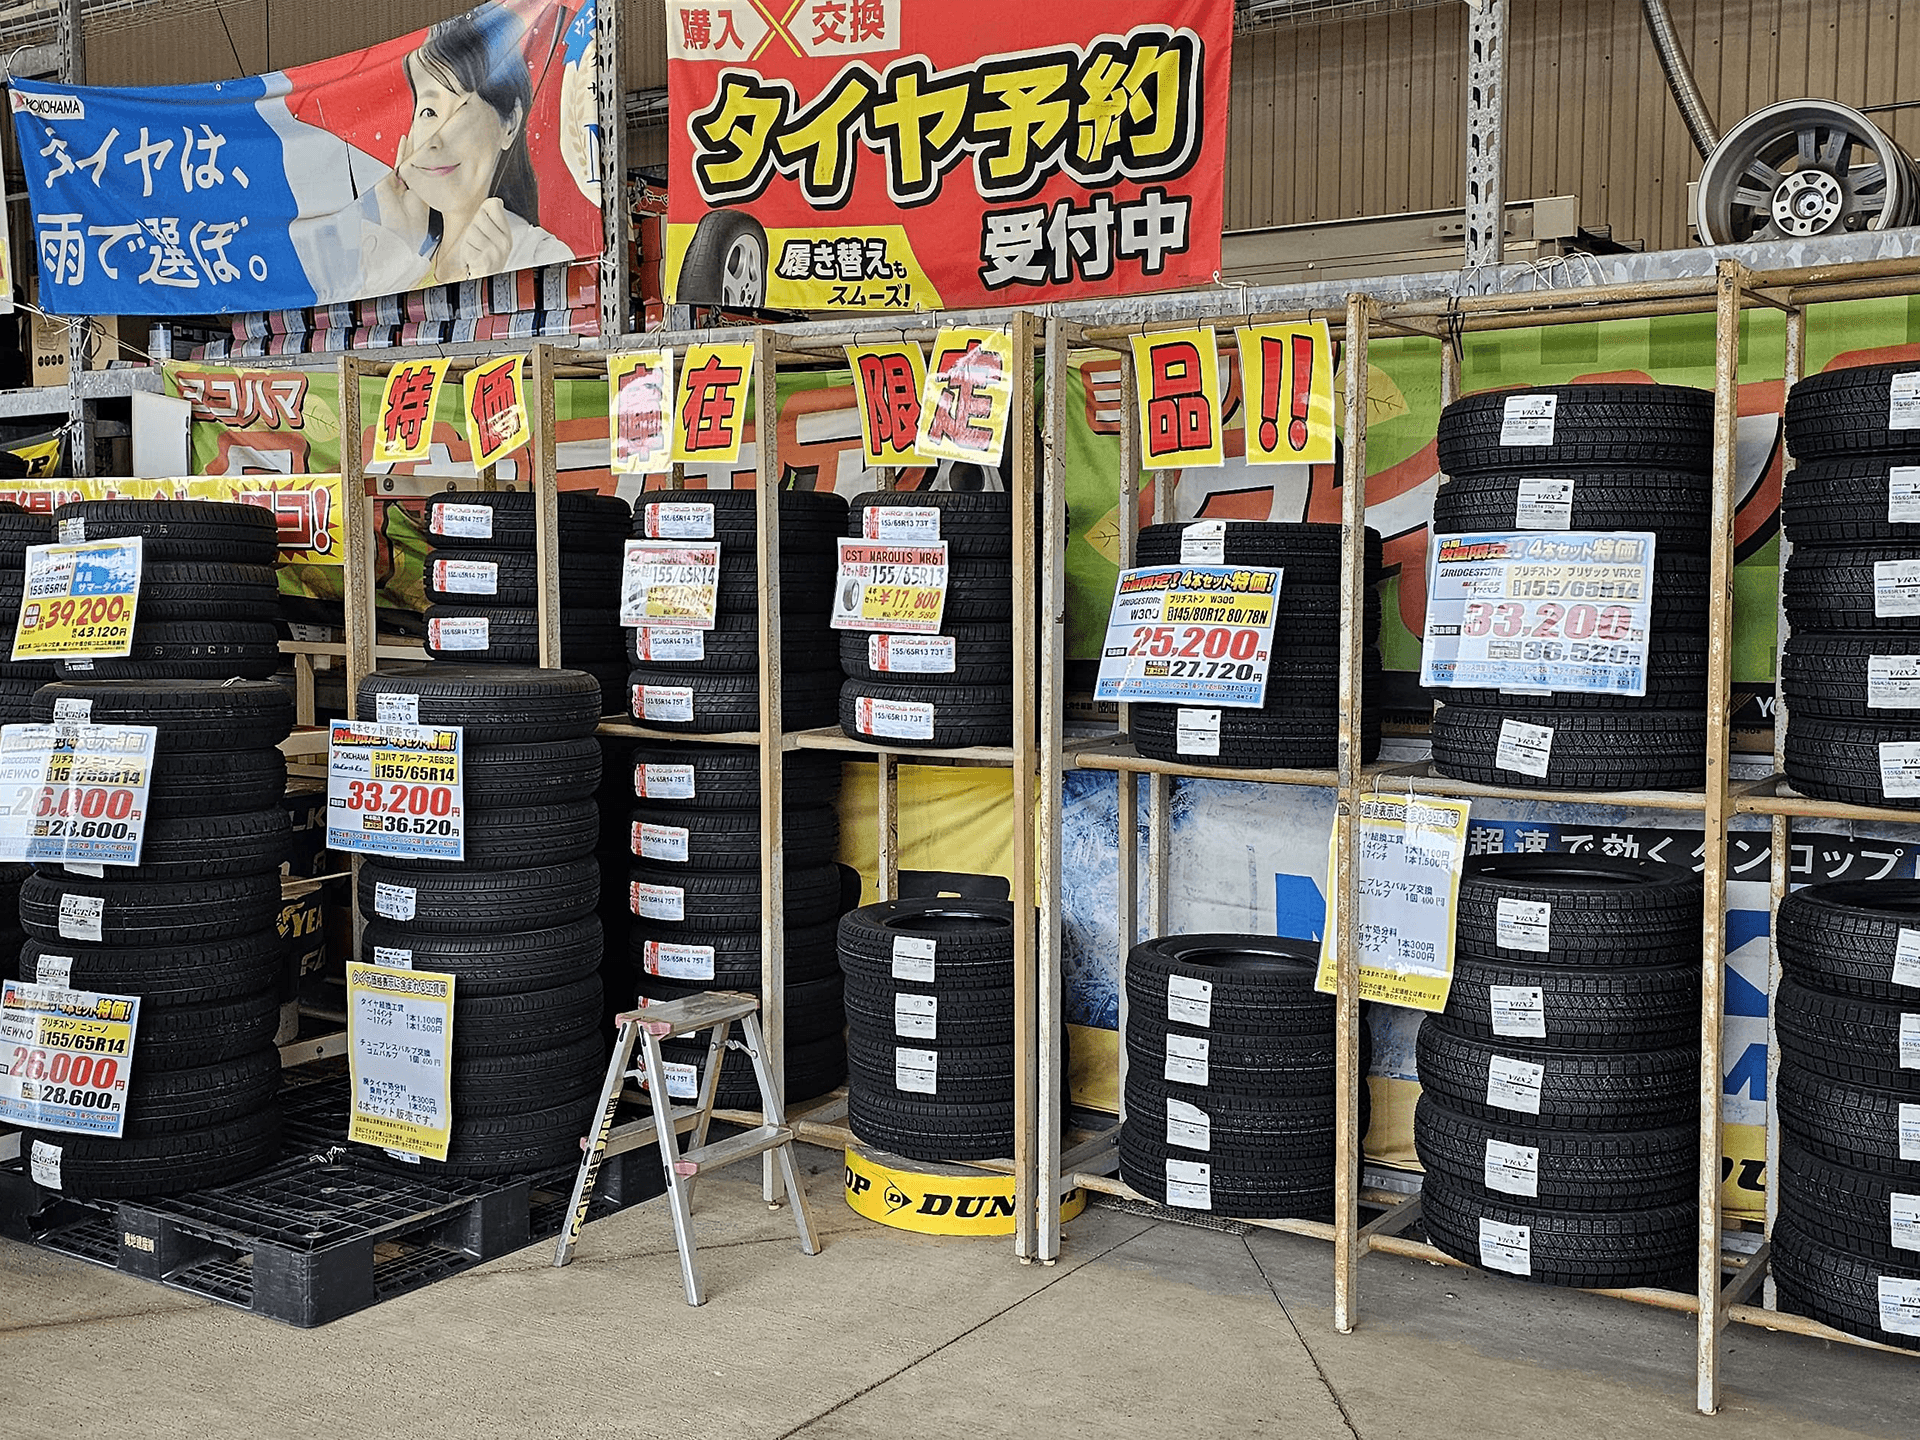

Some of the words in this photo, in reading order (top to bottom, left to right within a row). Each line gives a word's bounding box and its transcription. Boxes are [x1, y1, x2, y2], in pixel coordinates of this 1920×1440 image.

[681, 8, 744, 50] 購入
[811, 0, 885, 44] 交換
[25, 99, 80, 114] YOKOHAMA
[696, 38, 1195, 193] タイヤ予約
[41, 125, 249, 196] タイヤは、
[983, 194, 1190, 284] 受付中
[37, 214, 268, 289] 雨で選ぼ。
[780, 241, 906, 279] 履き替えも
[827, 284, 910, 307] スムーズ!
[176, 372, 306, 428] ヨコハマ
[385, 366, 436, 450] 特
[471, 360, 521, 458] 価
[683, 354, 744, 452] 在
[858, 353, 920, 456] 限
[929, 341, 1005, 451] 定
[1148, 340, 1213, 458] 品
[916, 519, 929, 527] 73T
[846, 550, 863, 562] CST
[870, 550, 913, 563] MARQUIS
[920, 552, 944, 566] MR61
[1528, 538, 1646, 563] 4本セット特価!
[872, 565, 945, 586] 155/65R13
[1440, 567, 1503, 578] BRIDGESTONE
[1613, 568, 1641, 578] VRX2
[1523, 579, 1641, 599] 155/65R14
[1211, 596, 1235, 604] W300
[1174, 606, 1224, 623] 145/80R12
[1227, 608, 1268, 624] 80/78N
[930, 648, 944, 656] 73T
[1128, 627, 1267, 661] 25,200円
[1171, 660, 1262, 682] 27,720円
[1889, 669, 1918, 677] VRX2
[910, 714, 922, 722] 73T
[381, 764, 455, 782] 155/65R14
[347, 781, 461, 818] 33,200円
[384, 815, 460, 838] 36,520円
[668, 838, 680, 846] 75T
[1515, 915, 1540, 923] VRX2
[1398, 939, 1435, 953] 1本300円
[1398, 948, 1435, 962] 1本500円
[1, 1025, 33, 1041] NEWNO
[46, 1031, 125, 1054] 155/65R14
[10, 1047, 125, 1091] 26,000円
[42, 1085, 120, 1112] 28,600円
